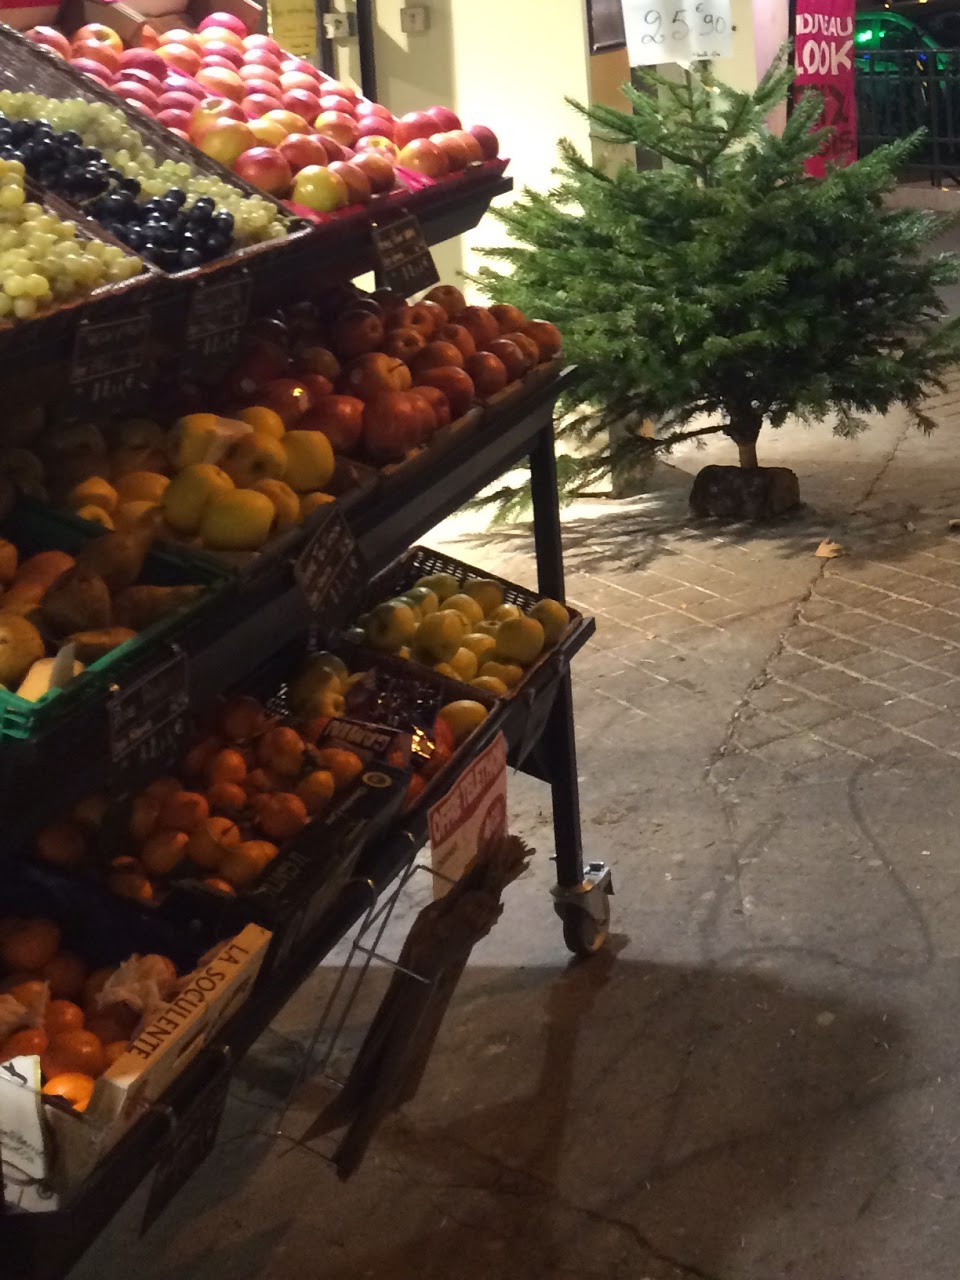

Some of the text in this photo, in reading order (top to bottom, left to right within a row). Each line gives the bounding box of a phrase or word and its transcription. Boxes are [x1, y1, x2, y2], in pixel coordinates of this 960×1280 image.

[793, 39, 854, 76] LOOK
[127, 943, 250, 1061] LA SOCULENTE
